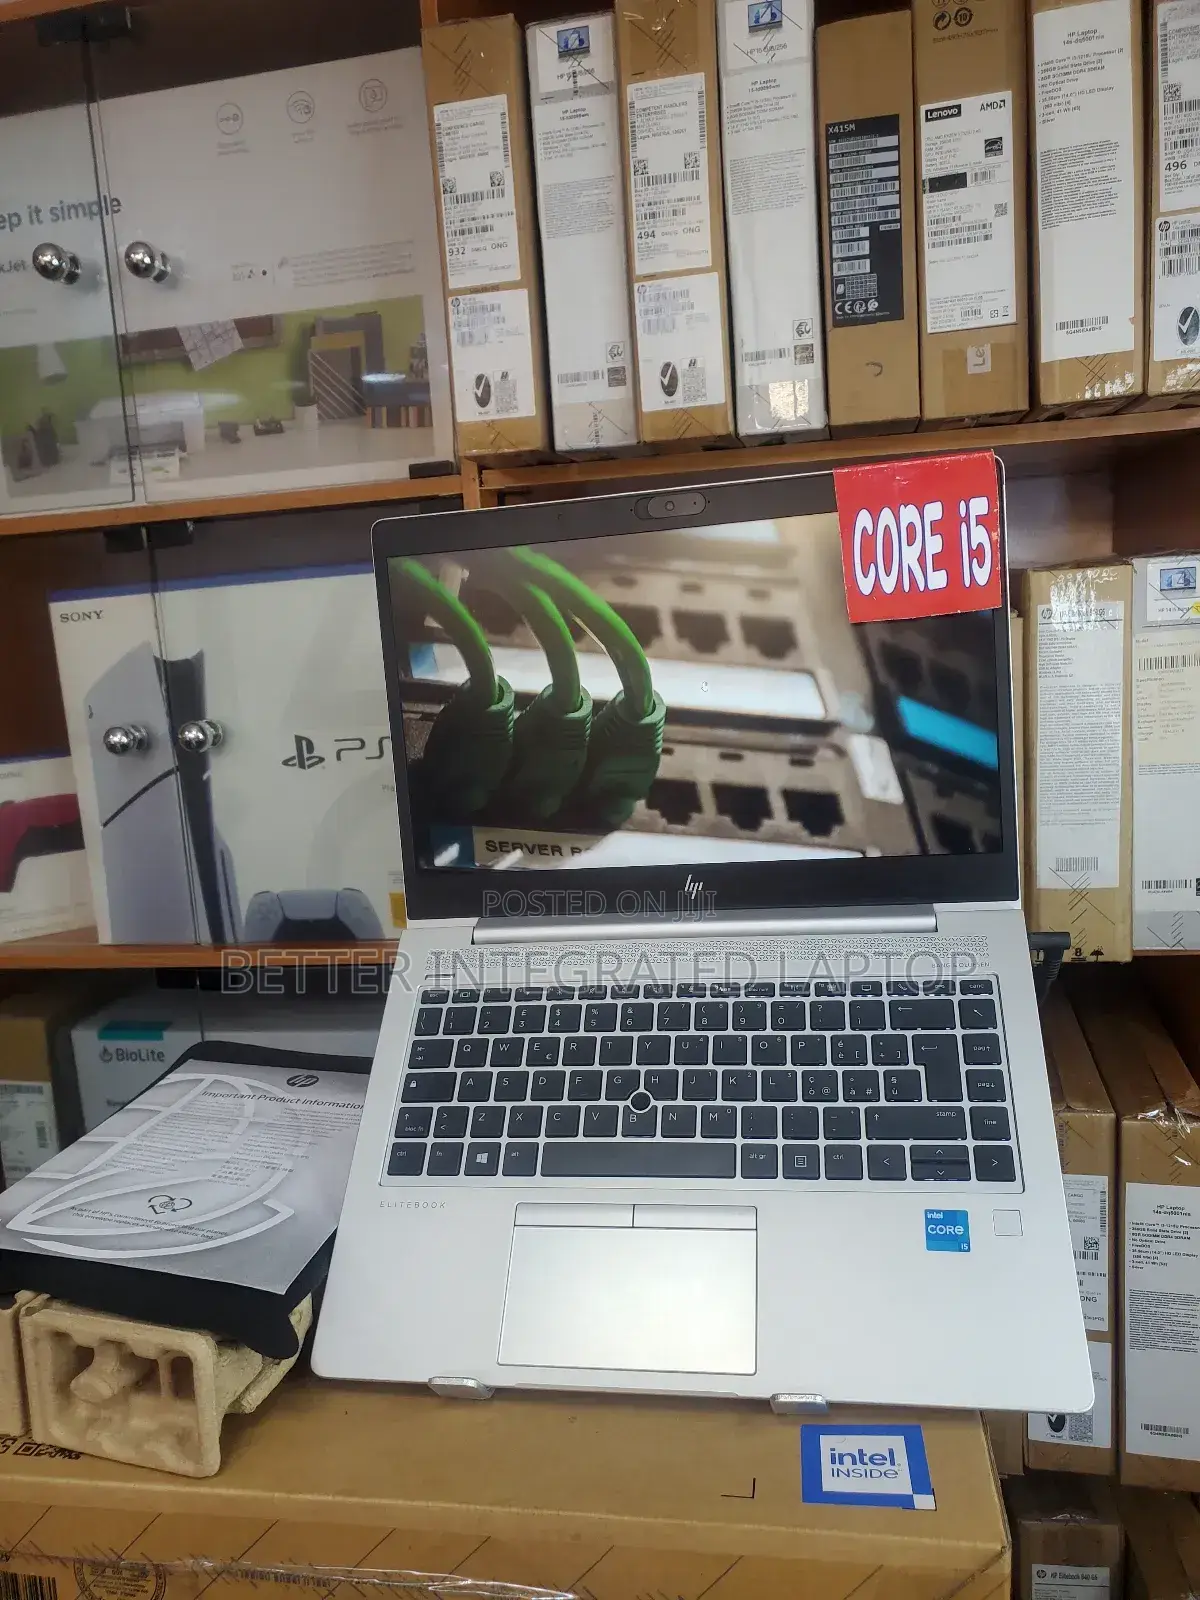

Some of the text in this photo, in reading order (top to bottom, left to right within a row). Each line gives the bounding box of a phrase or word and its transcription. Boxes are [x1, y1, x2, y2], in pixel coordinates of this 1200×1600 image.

[1076, 28, 1098, 37] Laptop
[1092, 49, 1117, 57] Processor
[759, 78, 777, 86] Laptop
[1096, 85, 1114, 93] Display
[636, 104, 663, 113] COMPETENT
[927, 100, 999, 119] Lenovo AMD
[828, 122, 856, 134] X415M
[1164, 160, 1188, 172] 496
[26, 204, 44, 226] it
[48, 194, 122, 222] simple
[637, 230, 656, 240] 494
[682, 226, 701, 235] ONG
[448, 246, 466, 257] 932
[490, 242, 508, 250] ONG
[853, 496, 992, 596] CORE i5
[59, 610, 103, 623] SONY
[485, 840, 564, 857] SERVER
[626, 1018, 633, 1026] 6
[664, 1018, 670, 1026] 7
[463, 1044, 472, 1052] Q
[499, 1043, 510, 1051] W
[533, 1042, 541, 1051] E
[570, 1042, 578, 1050] R
[798, 1042, 806, 1050] P
[115, 1047, 166, 1063] BioLite
[466, 1078, 474, 1086] A
[502, 1078, 509, 1086] S
[538, 1077, 547, 1085] D
[575, 1076, 582, 1084] F
[613, 1076, 622, 1084] G
[651, 1076, 659, 1084] H
[690, 1076, 696, 1084] J
[729, 1076, 737, 1085] K
[769, 1076, 776, 1085] L
[202, 1090, 257, 1100] Important
[257, 1094, 301, 1105] Product
[478, 1112, 486, 1122] Z
[515, 1112, 524, 1121] X
[553, 1112, 561, 1121] C
[591, 1112, 600, 1121] V
[629, 1114, 637, 1123] B
[668, 1112, 677, 1121] N
[709, 1112, 718, 1121] M
[380, 1200, 446, 1209] ELITEBOOK
[113, 1212, 154, 1223] commitment
[926, 1211, 944, 1219] intel
[1079, 1295, 1098, 1303] ONG
[830, 1447, 896, 1467] intel
